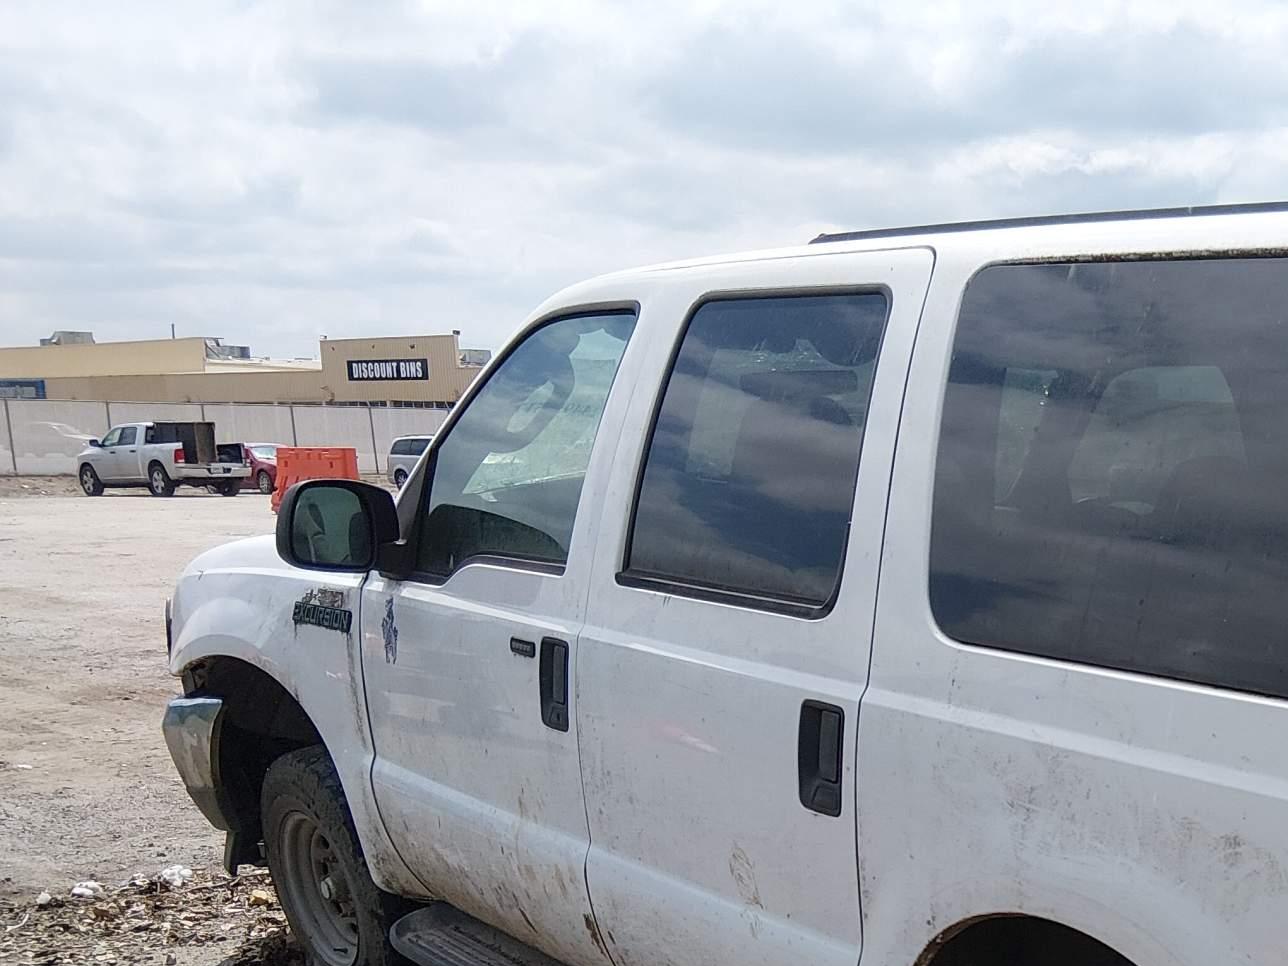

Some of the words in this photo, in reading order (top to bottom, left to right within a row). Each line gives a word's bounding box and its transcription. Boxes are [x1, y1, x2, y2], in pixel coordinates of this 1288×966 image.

[351, 361, 398, 379] DISCOUNT
[399, 361, 423, 378] BINS
[293, 602, 350, 632] EXCURSION
